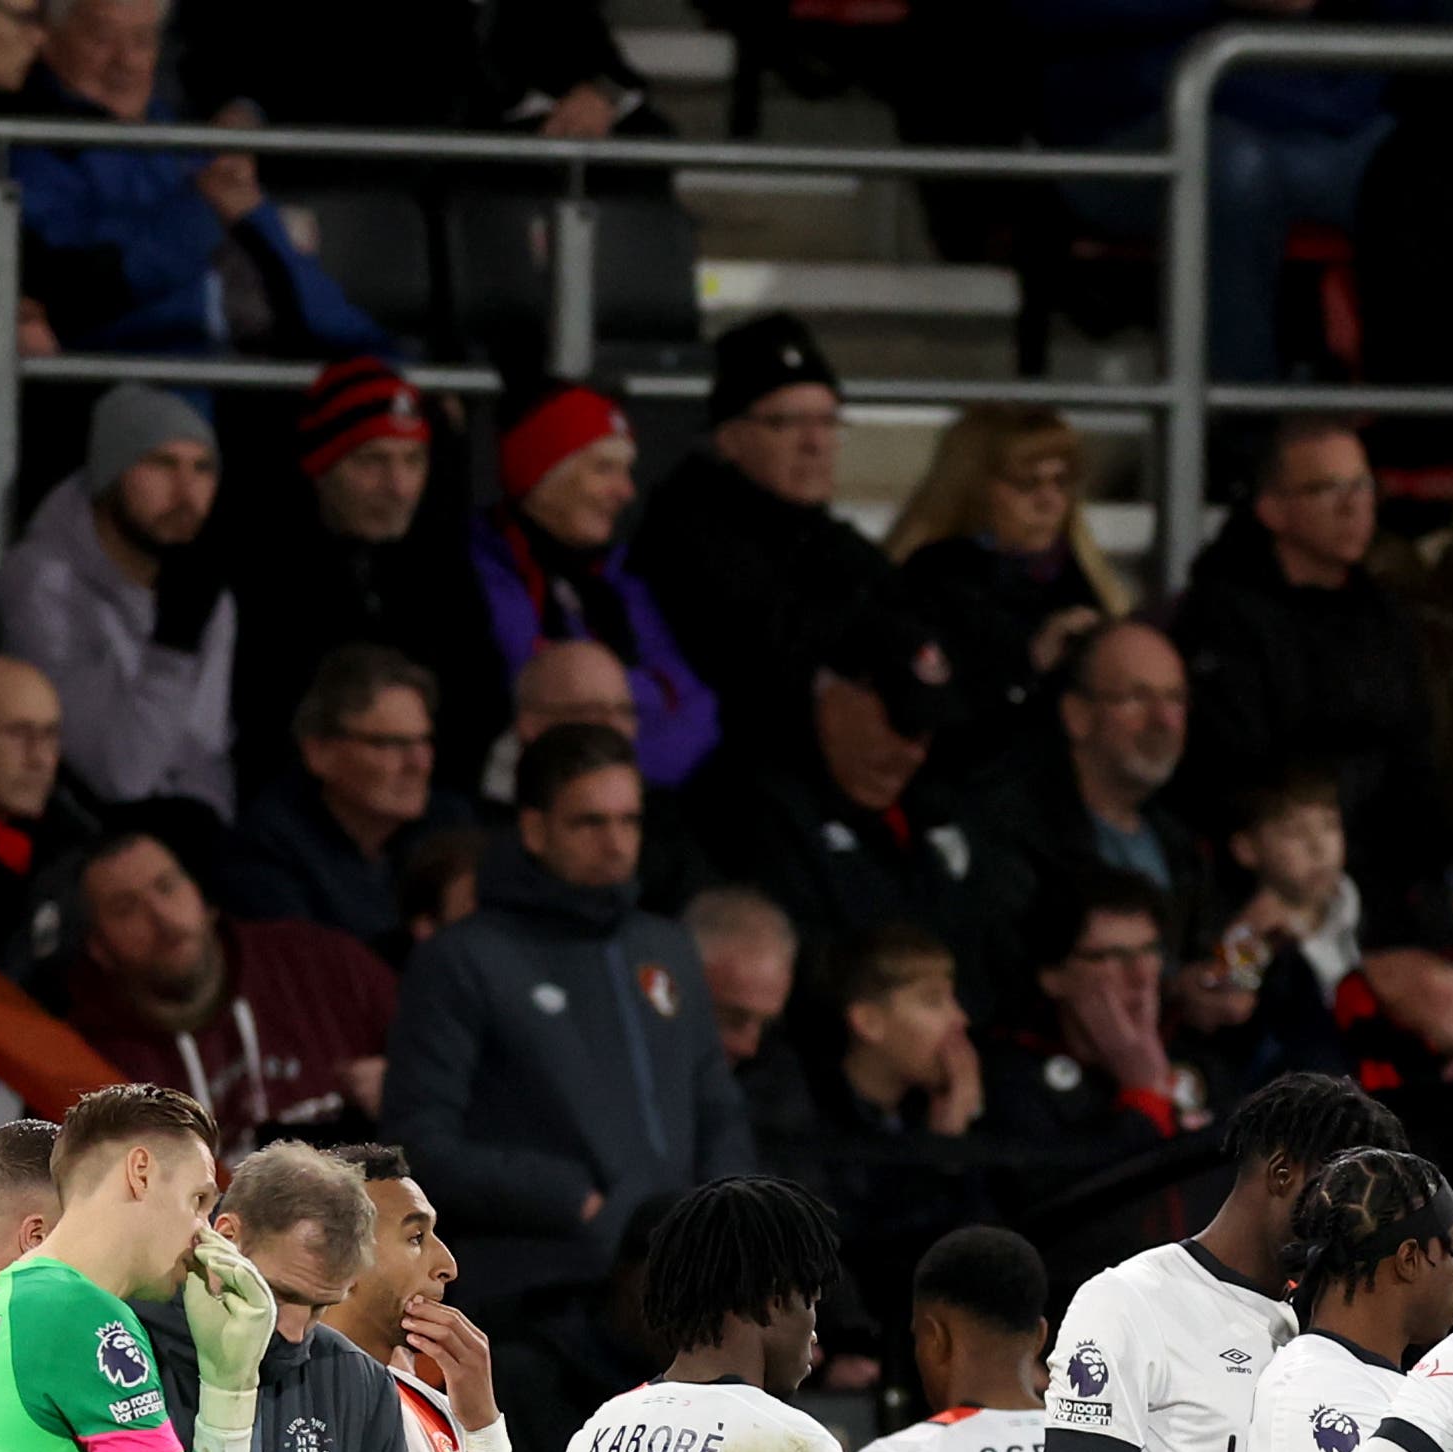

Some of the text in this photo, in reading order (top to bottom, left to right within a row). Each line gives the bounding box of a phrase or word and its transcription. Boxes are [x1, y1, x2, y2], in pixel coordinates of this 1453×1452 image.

[109, 1390, 159, 1414] No room
[1056, 1399, 1108, 1416] No room
[1071, 1413, 1112, 1426] racism
